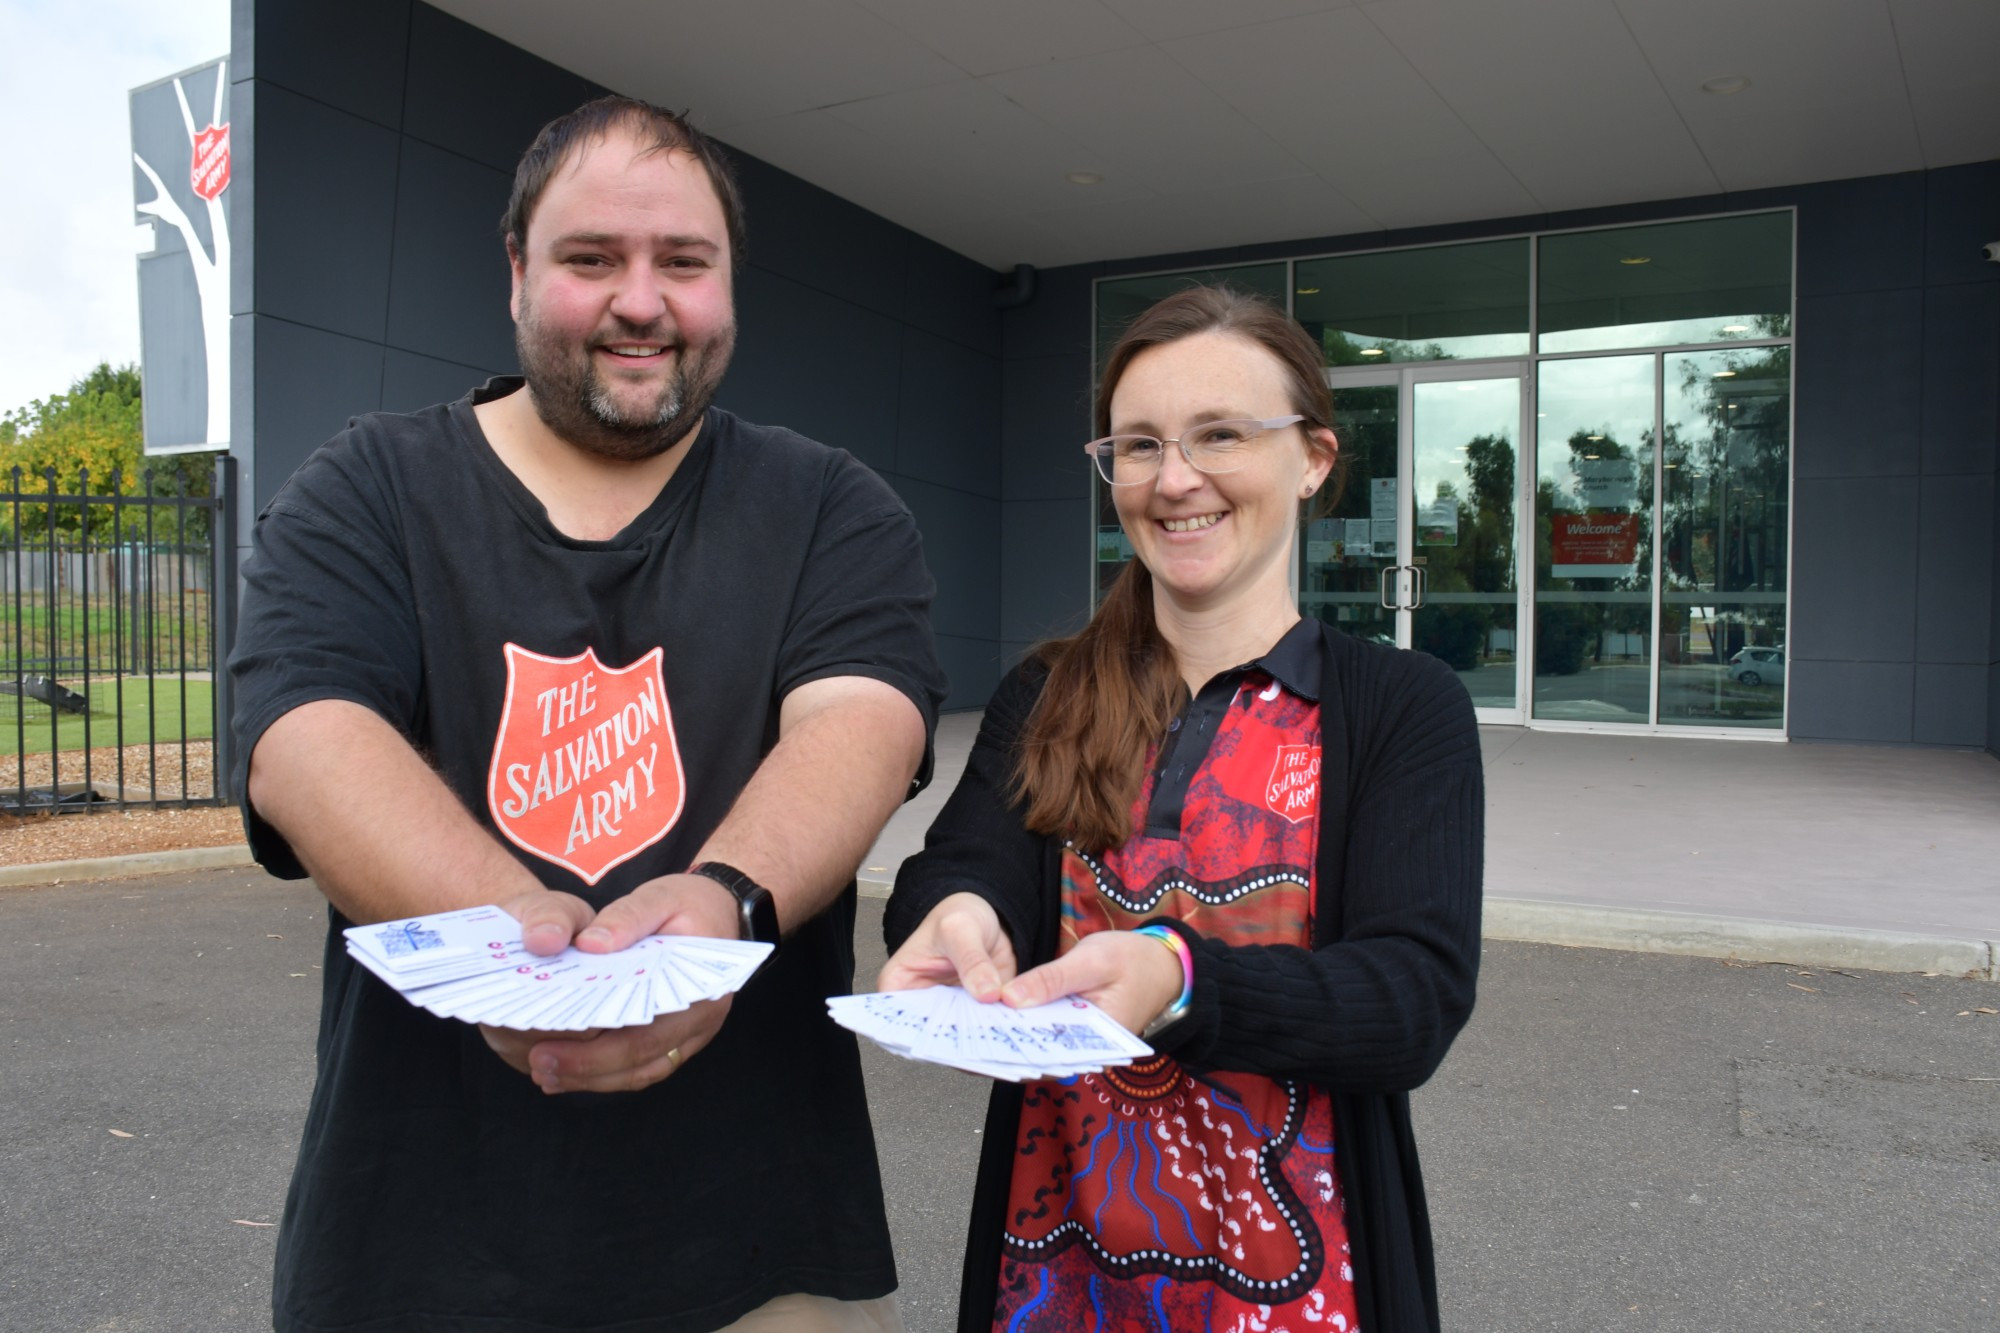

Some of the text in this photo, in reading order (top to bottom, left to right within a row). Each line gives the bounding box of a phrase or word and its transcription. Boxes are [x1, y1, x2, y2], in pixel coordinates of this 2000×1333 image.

[193, 133, 227, 187] SALVATION
[198, 133, 214, 160] THE
[205, 155, 227, 193] ARMY
[1567, 524, 1622, 534] Welcome
[537, 670, 598, 738] THE
[501, 676, 660, 819] SALVATION
[563, 742, 658, 857] ARMY
[1285, 781, 1318, 812] ARM
